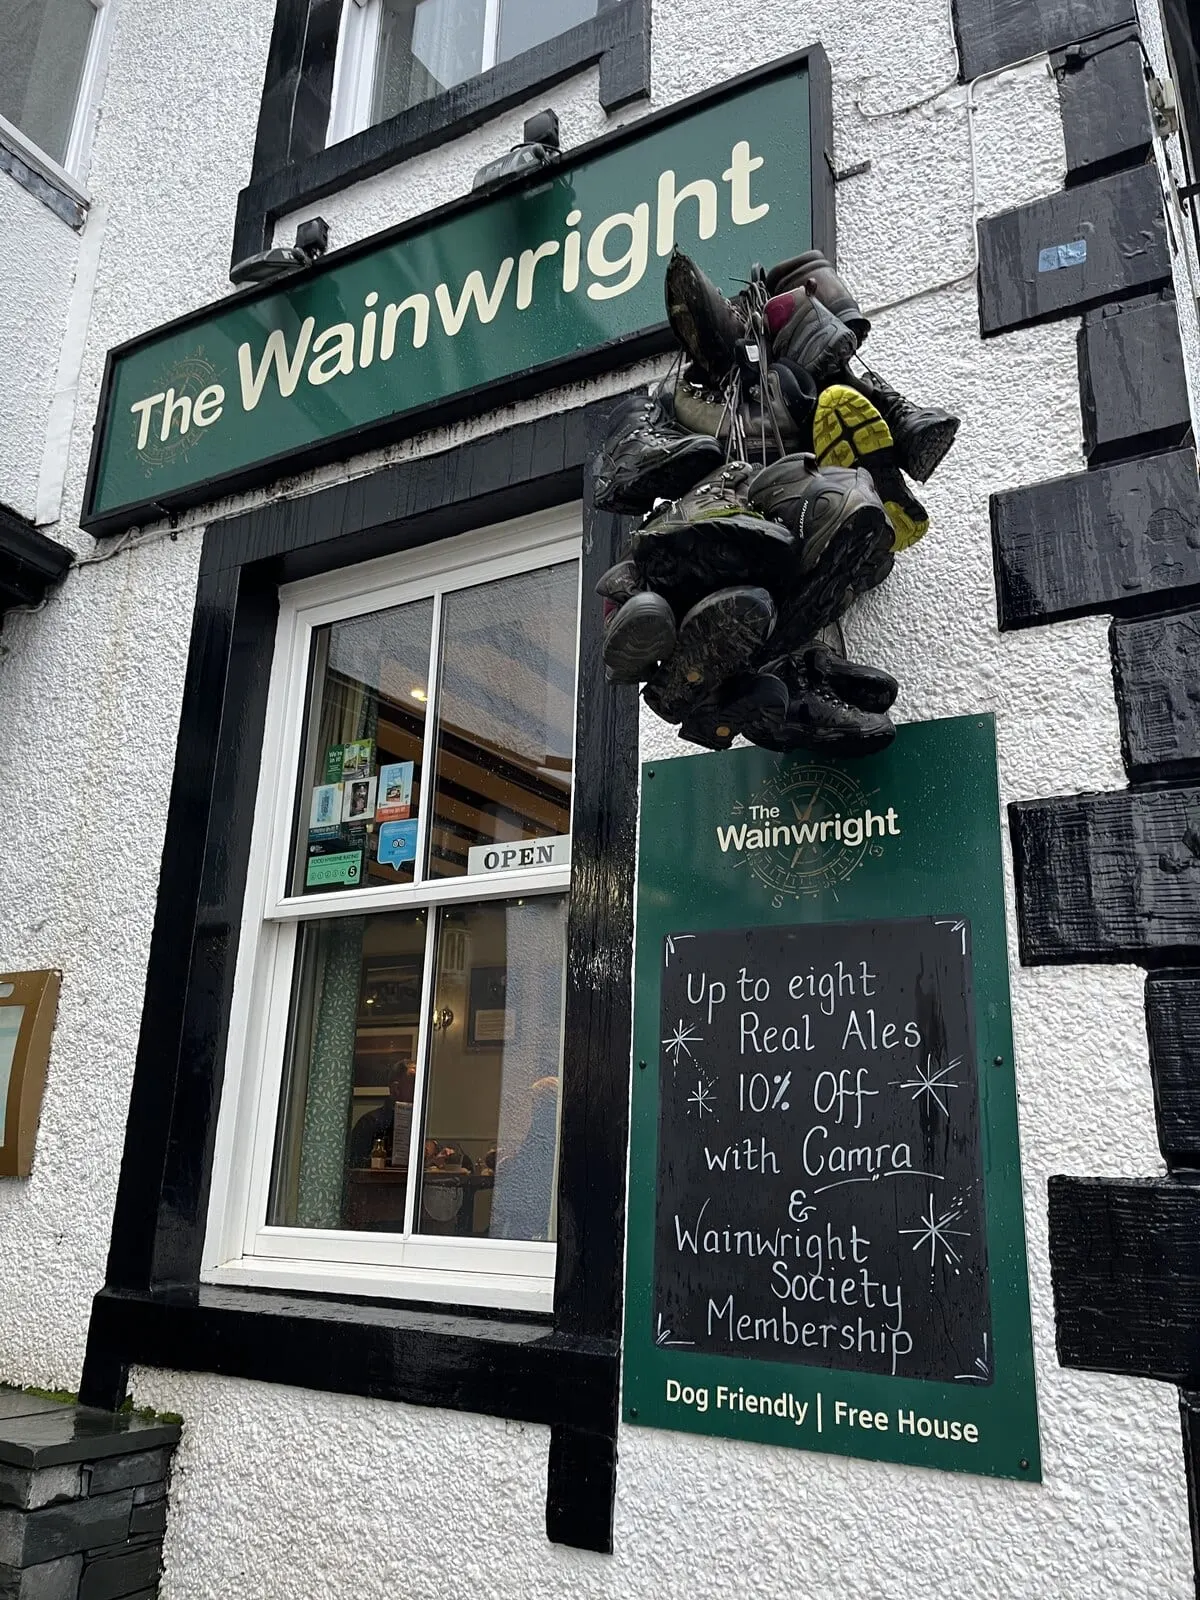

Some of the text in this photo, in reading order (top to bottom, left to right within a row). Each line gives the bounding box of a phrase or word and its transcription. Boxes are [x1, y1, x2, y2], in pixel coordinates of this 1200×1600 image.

[130, 140, 770, 451] The Wainwright
[716, 807, 901, 853] Wainwright
[748, 804, 780, 821] The
[484, 845, 555, 870] OPEN
[686, 961, 876, 1024] Up to eight
[739, 1009, 922, 1055] Real Ales
[739, 1068, 880, 1129] 10% Off
[704, 1126, 913, 1177] with Camra
[788, 1189, 817, 1223] &
[674, 1198, 871, 1276] Wainwright
[771, 1260, 903, 1332] Society
[707, 1295, 913, 1376] Membership
[666, 1379, 709, 1412] Dog
[716, 1386, 809, 1426] Friendly
[834, 1401, 889, 1432] Free
[897, 1409, 980, 1444] House
